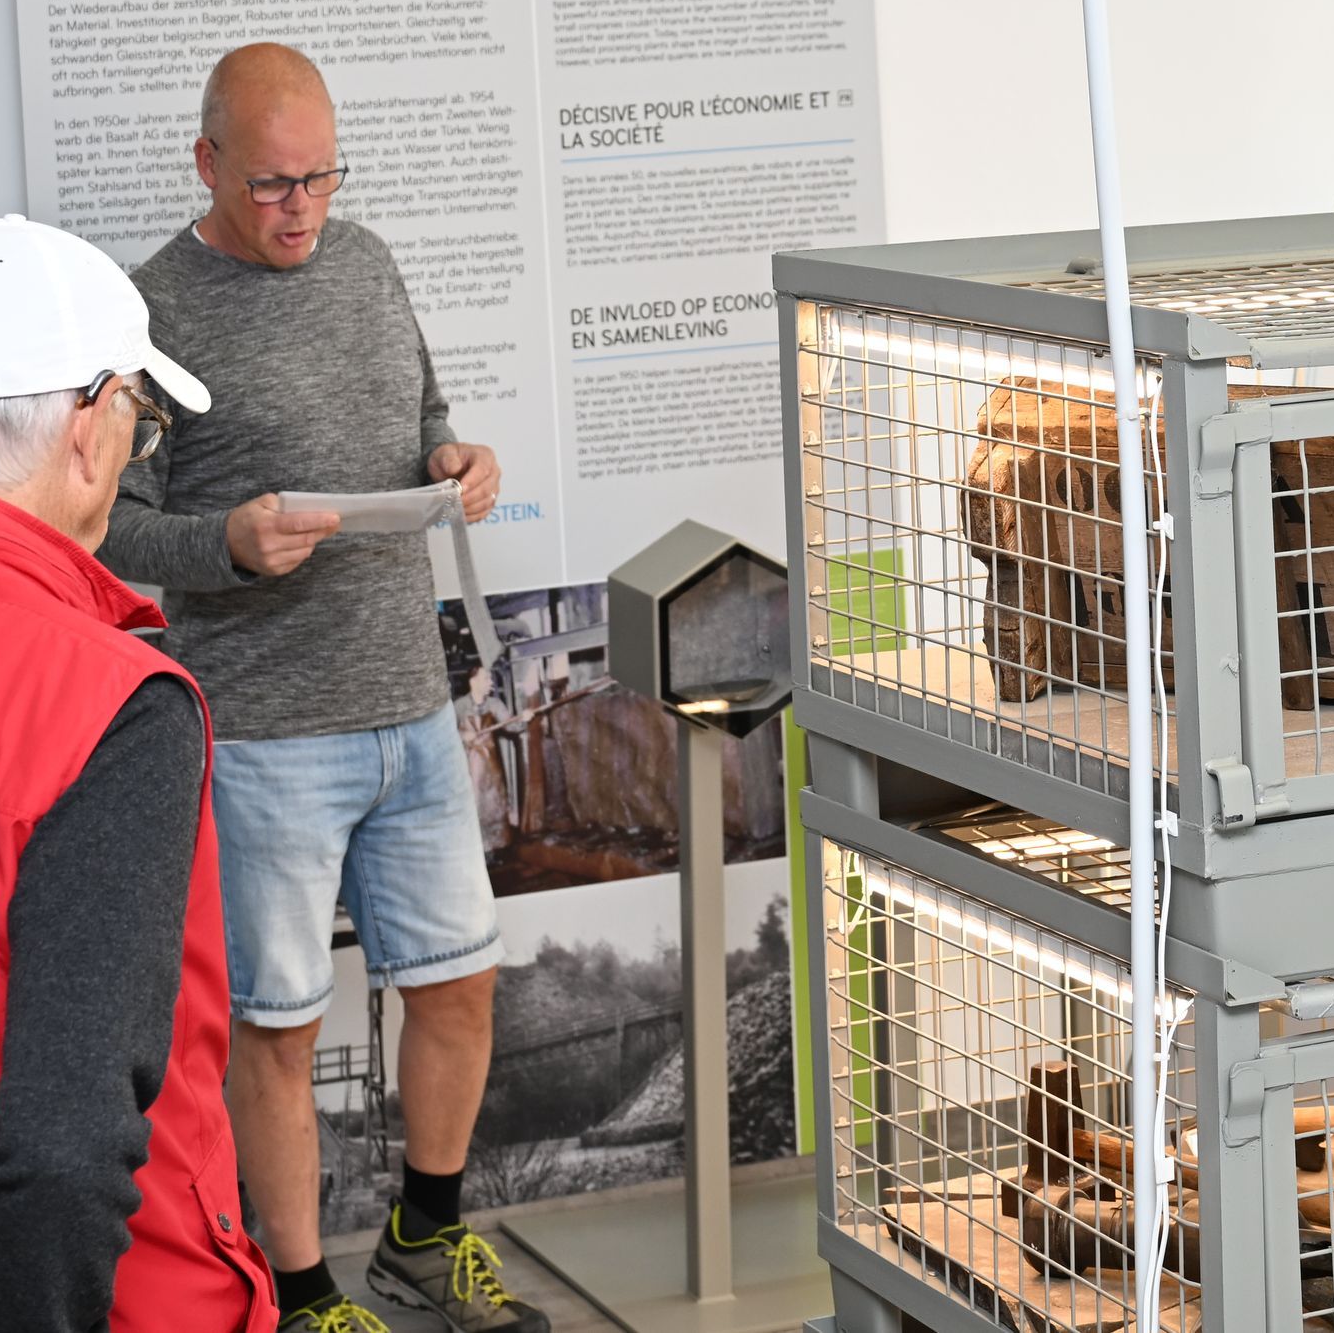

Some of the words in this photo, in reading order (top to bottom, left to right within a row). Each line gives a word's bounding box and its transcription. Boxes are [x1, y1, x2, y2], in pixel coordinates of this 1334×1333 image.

[189, 47, 231, 57] Kippwa
[559, 103, 638, 127] DÉCISIVE
[643, 100, 695, 125] POUR
[700, 92, 804, 117] L'ÉCONOMIE
[809, 90, 830, 110] ET
[560, 131, 585, 150] LA
[589, 122, 664, 148] SOCIÉTÉ
[136, 162, 195, 173] Gattersäge
[397, 252, 468, 265] rukturprojekte
[570, 307, 594, 326] DE
[600, 300, 676, 323] INVLOED
[681, 297, 708, 317] OP
[713, 293, 778, 313] ECONO
[571, 331, 596, 350] EN
[601, 318, 728, 347] SAMENLEVING
[431, 342, 517, 356] klearkatastrophe
